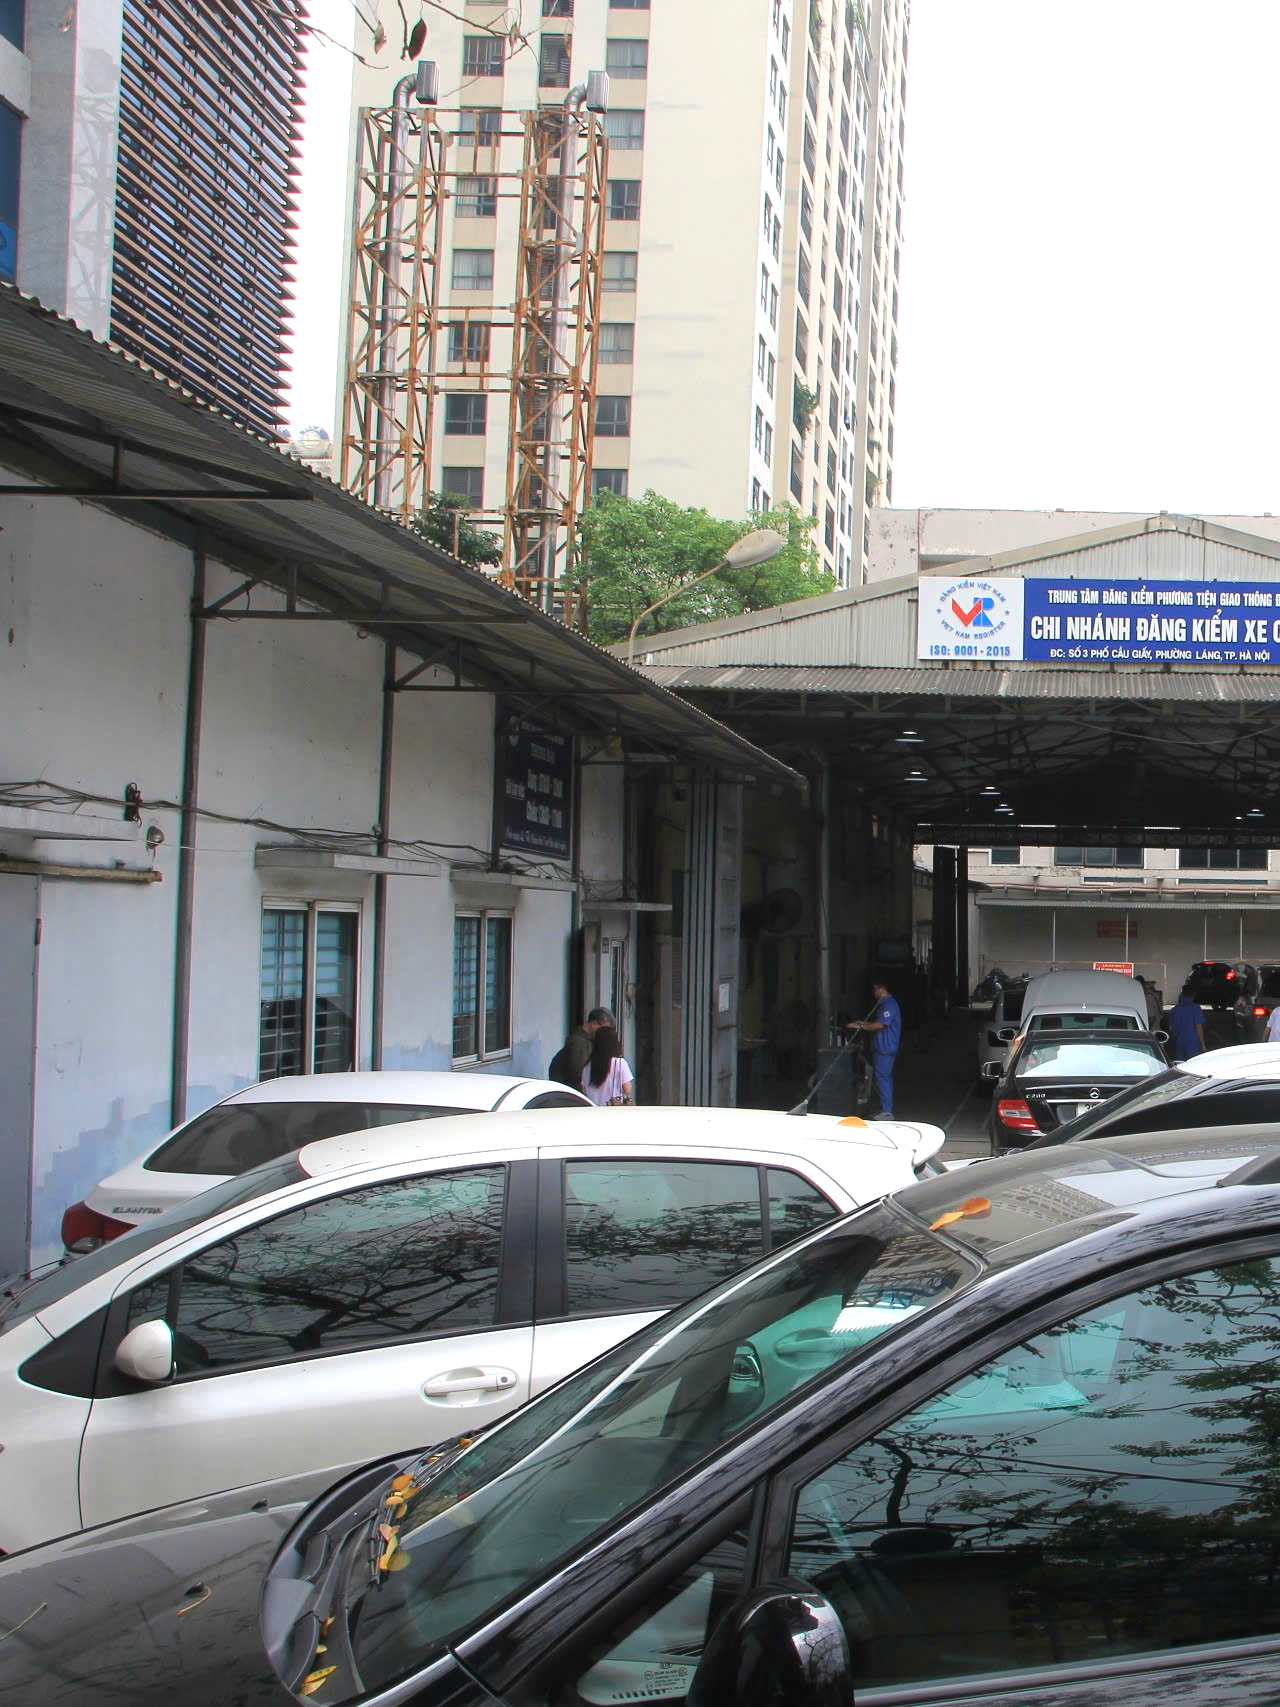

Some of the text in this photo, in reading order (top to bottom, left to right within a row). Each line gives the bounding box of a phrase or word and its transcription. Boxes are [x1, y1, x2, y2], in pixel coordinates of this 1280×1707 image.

[992, 588, 1007, 602] NAM
[1048, 589, 1078, 604] TRUNG
[1080, 587, 1099, 604] TÂM
[1102, 588, 1128, 605] ĐĂNG
[1130, 585, 1154, 605] KIỂM
[1156, 590, 1193, 606] PHƯƠNG
[1196, 590, 1217, 608] TIỆN
[1220, 592, 1241, 607] GIAO
[1243, 591, 1273, 607] THÔNG
[954, 630, 970, 639] NAM
[973, 620, 1006, 639] REGISTER
[1031, 616, 1061, 640] CHI
[1066, 612, 1131, 641] NHÁNH
[1136, 614, 1187, 642] ĐĂNG
[1192, 608, 1238, 643] KIỂM
[1244, 619, 1268, 643] XE
[930, 645, 951, 656] ISO:
[986, 646, 1011, 656] 2015
[1050, 645, 1270, 662] ĐC: SỐ 3 PHỐ CẦU GIẤY, PHƯỜNG LÁNG, TP. HÀ NỘI
[112, 1206, 163, 1214] ELANTRA
